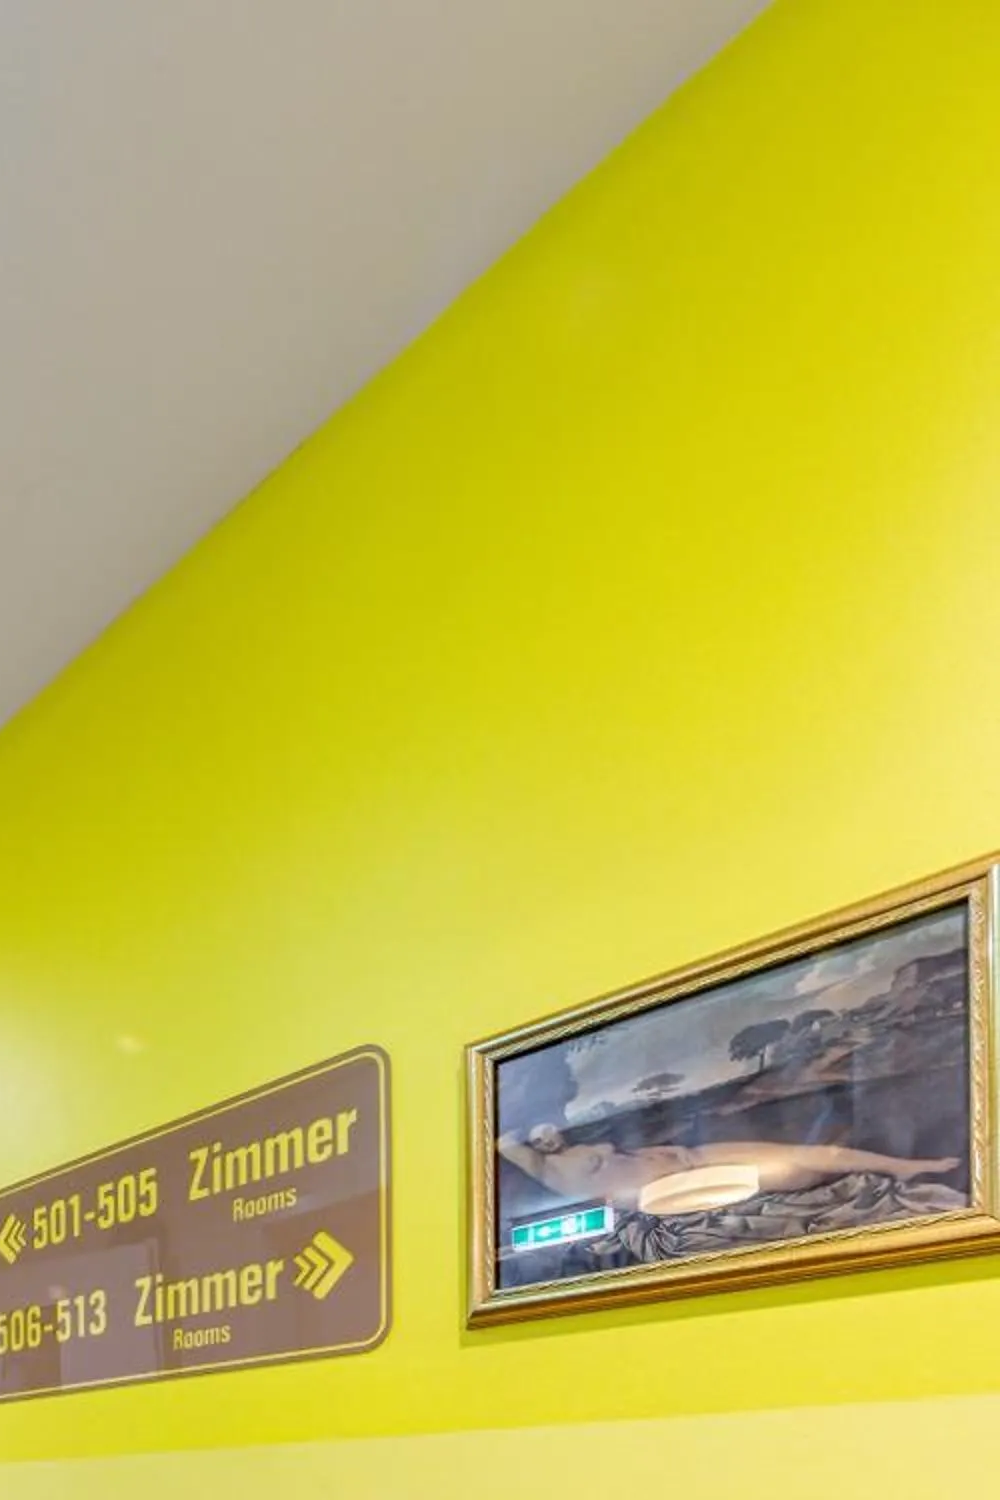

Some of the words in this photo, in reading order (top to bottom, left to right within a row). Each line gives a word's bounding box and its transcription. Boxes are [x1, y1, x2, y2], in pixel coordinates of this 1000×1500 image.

[32, 1167, 158, 1249] 501-505
[188, 1108, 358, 1201] Zimmer
[232, 1186, 297, 1222] Rooms
[134, 1257, 285, 1327] Zimmer
[173, 1325, 231, 1350] Rooms
